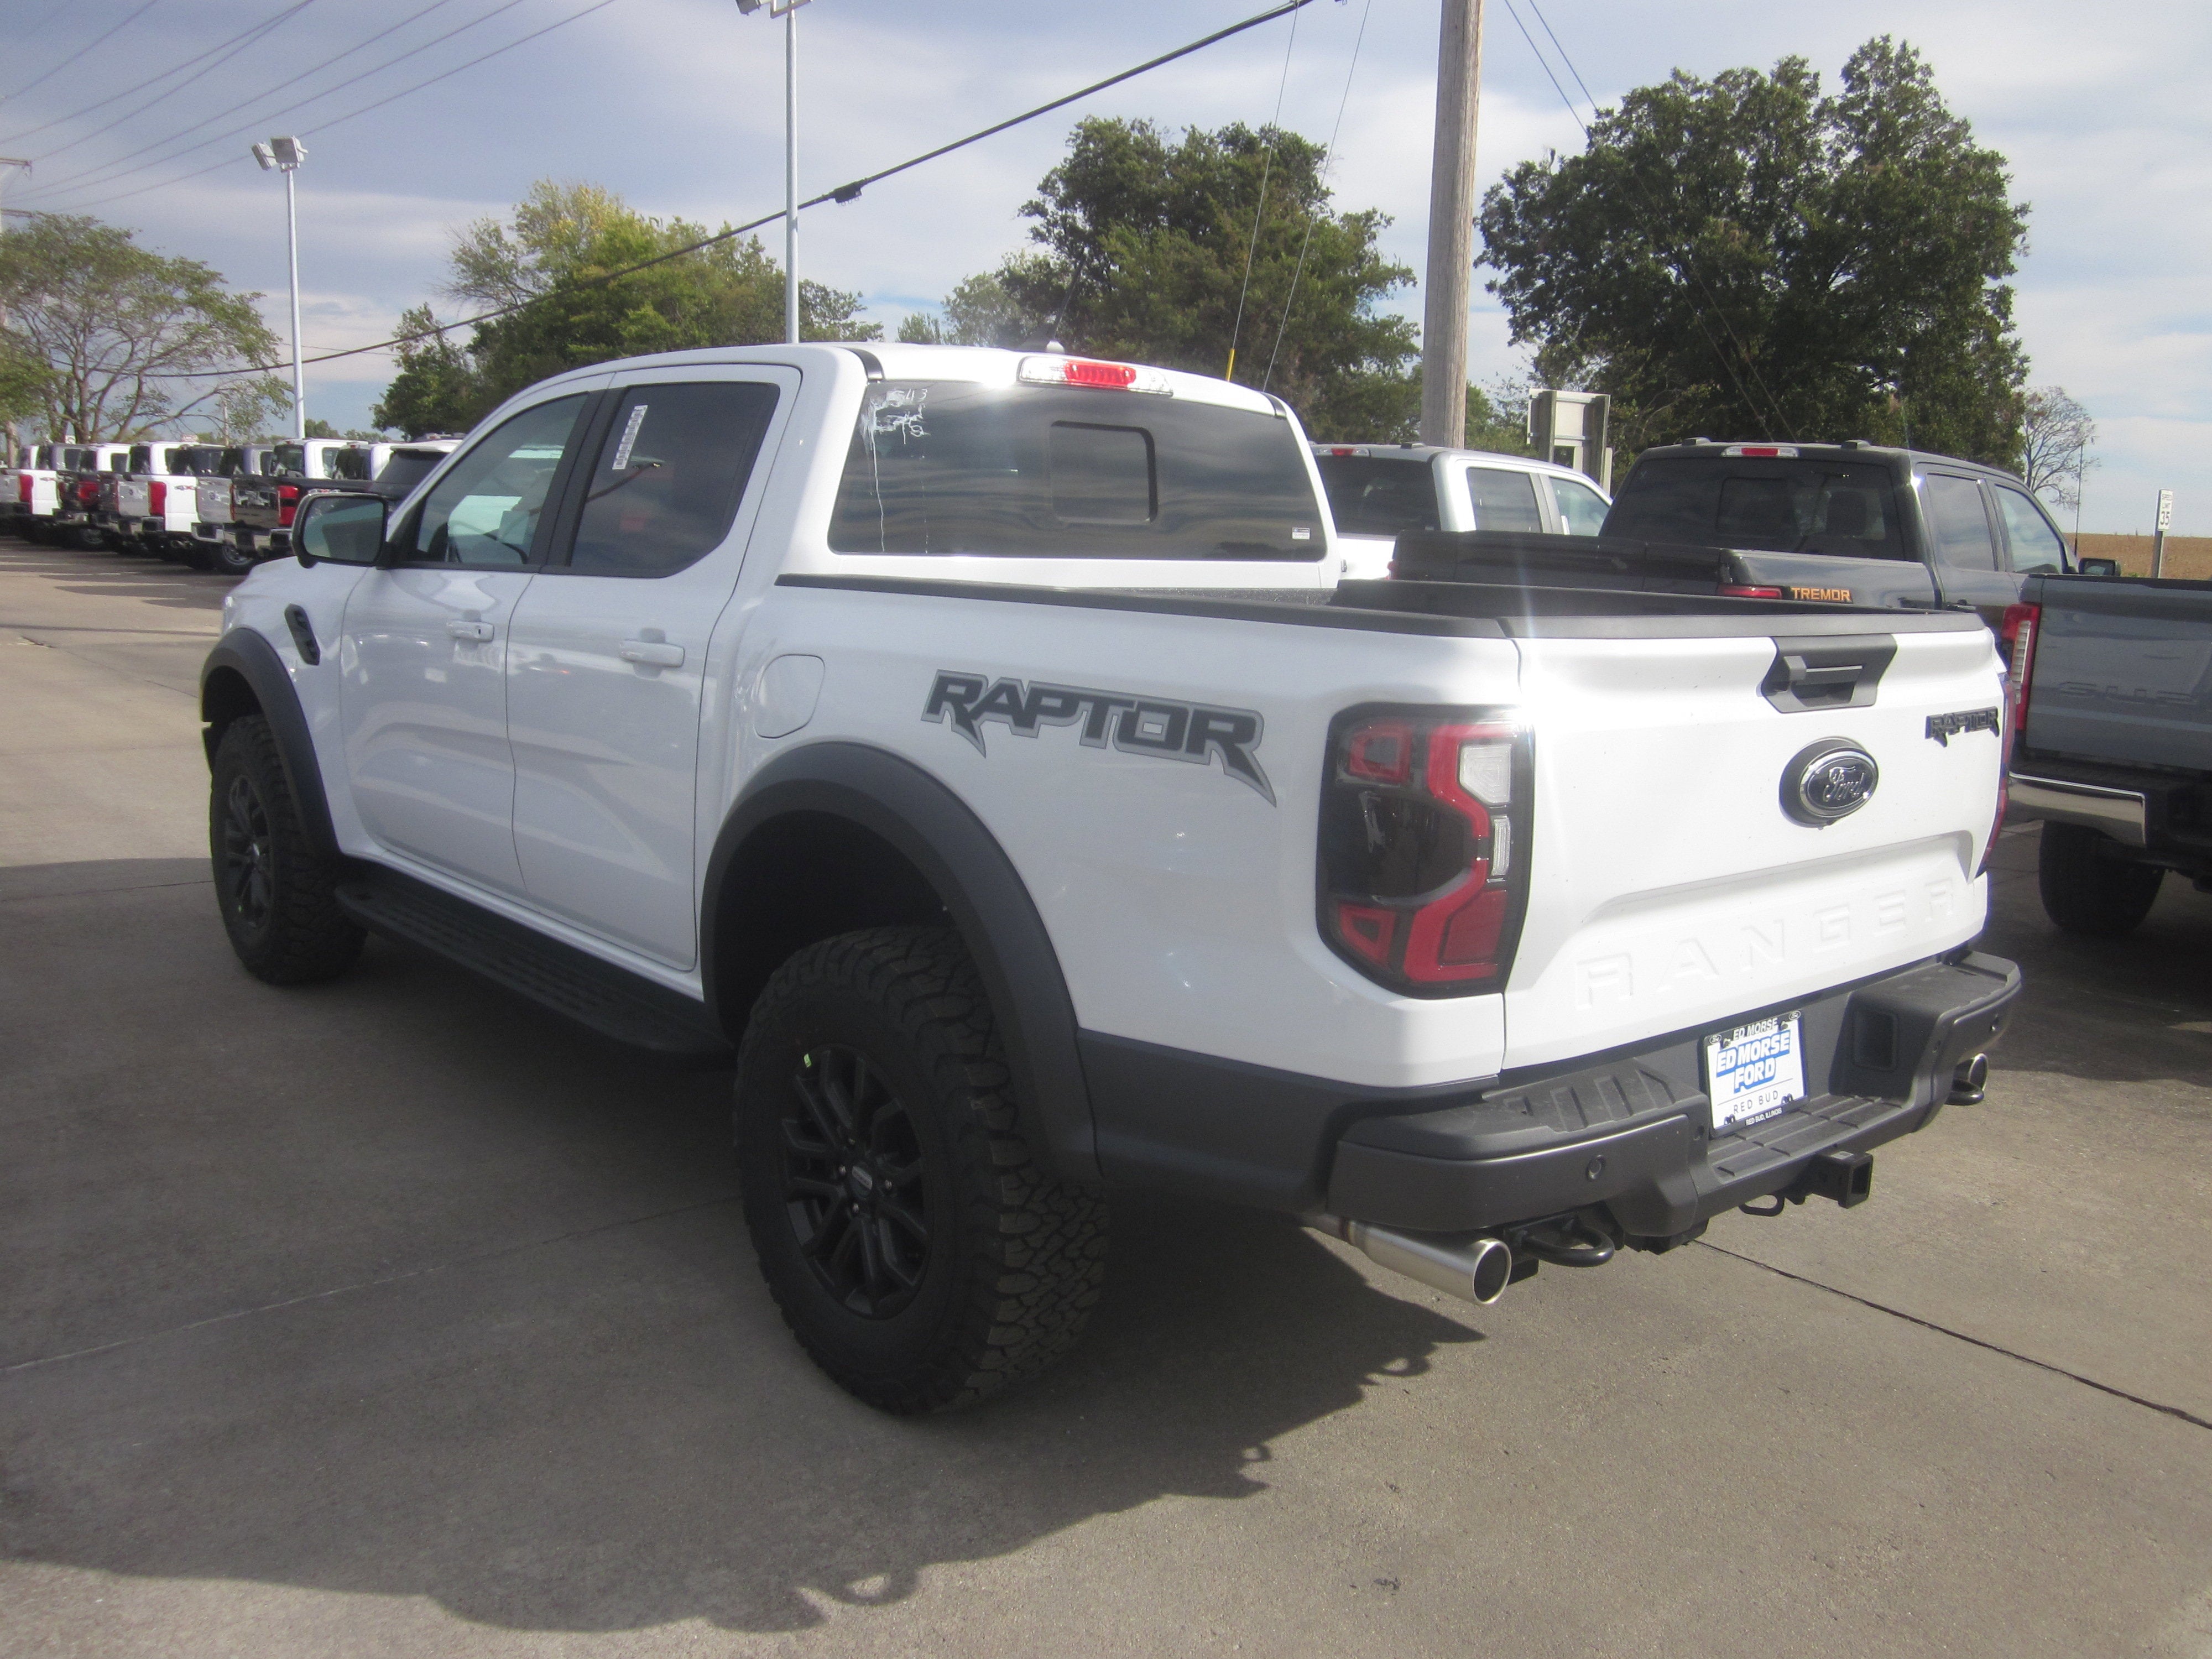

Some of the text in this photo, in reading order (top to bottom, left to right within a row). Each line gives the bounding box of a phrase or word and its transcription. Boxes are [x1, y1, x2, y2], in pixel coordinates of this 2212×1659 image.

[2160, 510, 2170, 526] 35
[1791, 587, 1851, 602] TREMOR
[921, 669, 1277, 807] RAPTOR
[1925, 706, 2000, 748] RAPTOR
[1823, 766, 1866, 802] Ford
[1575, 877, 1954, 1010] RANGER
[1733, 1017, 1778, 1041] ED MORSE
[1717, 1030, 1791, 1077] ED MORSE
[1734, 1057, 1776, 1093] FORD
[1734, 1091, 1778, 1114] RED BUD
